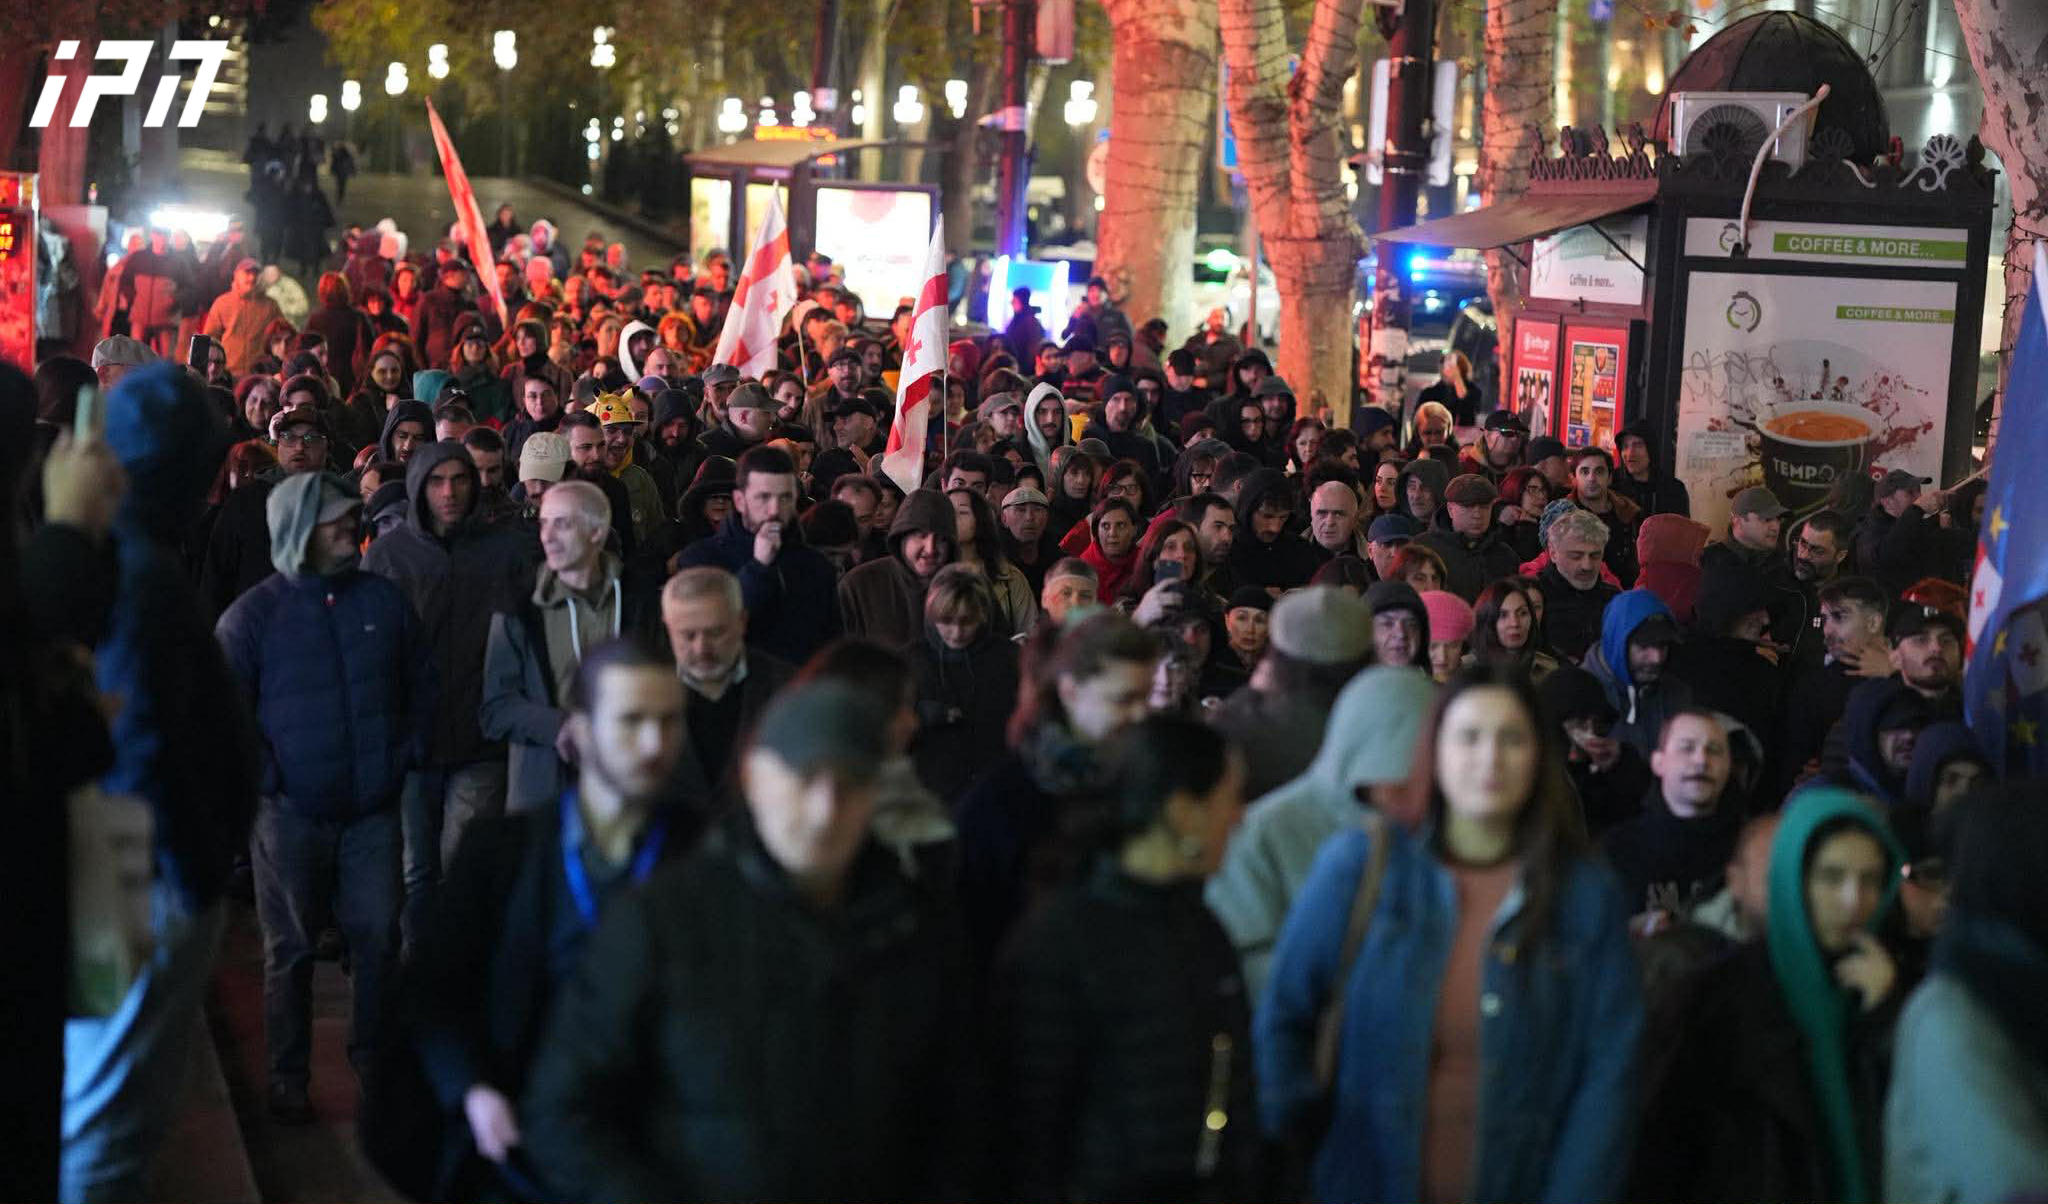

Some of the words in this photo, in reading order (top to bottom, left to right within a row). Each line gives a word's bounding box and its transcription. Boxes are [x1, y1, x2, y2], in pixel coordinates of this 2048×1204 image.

[1788, 236, 1853, 254] COFFEE
[1856, 241, 1866, 254] &
[1845, 307, 1893, 319] COFFEE
[1773, 457, 1835, 481] TEMPO
